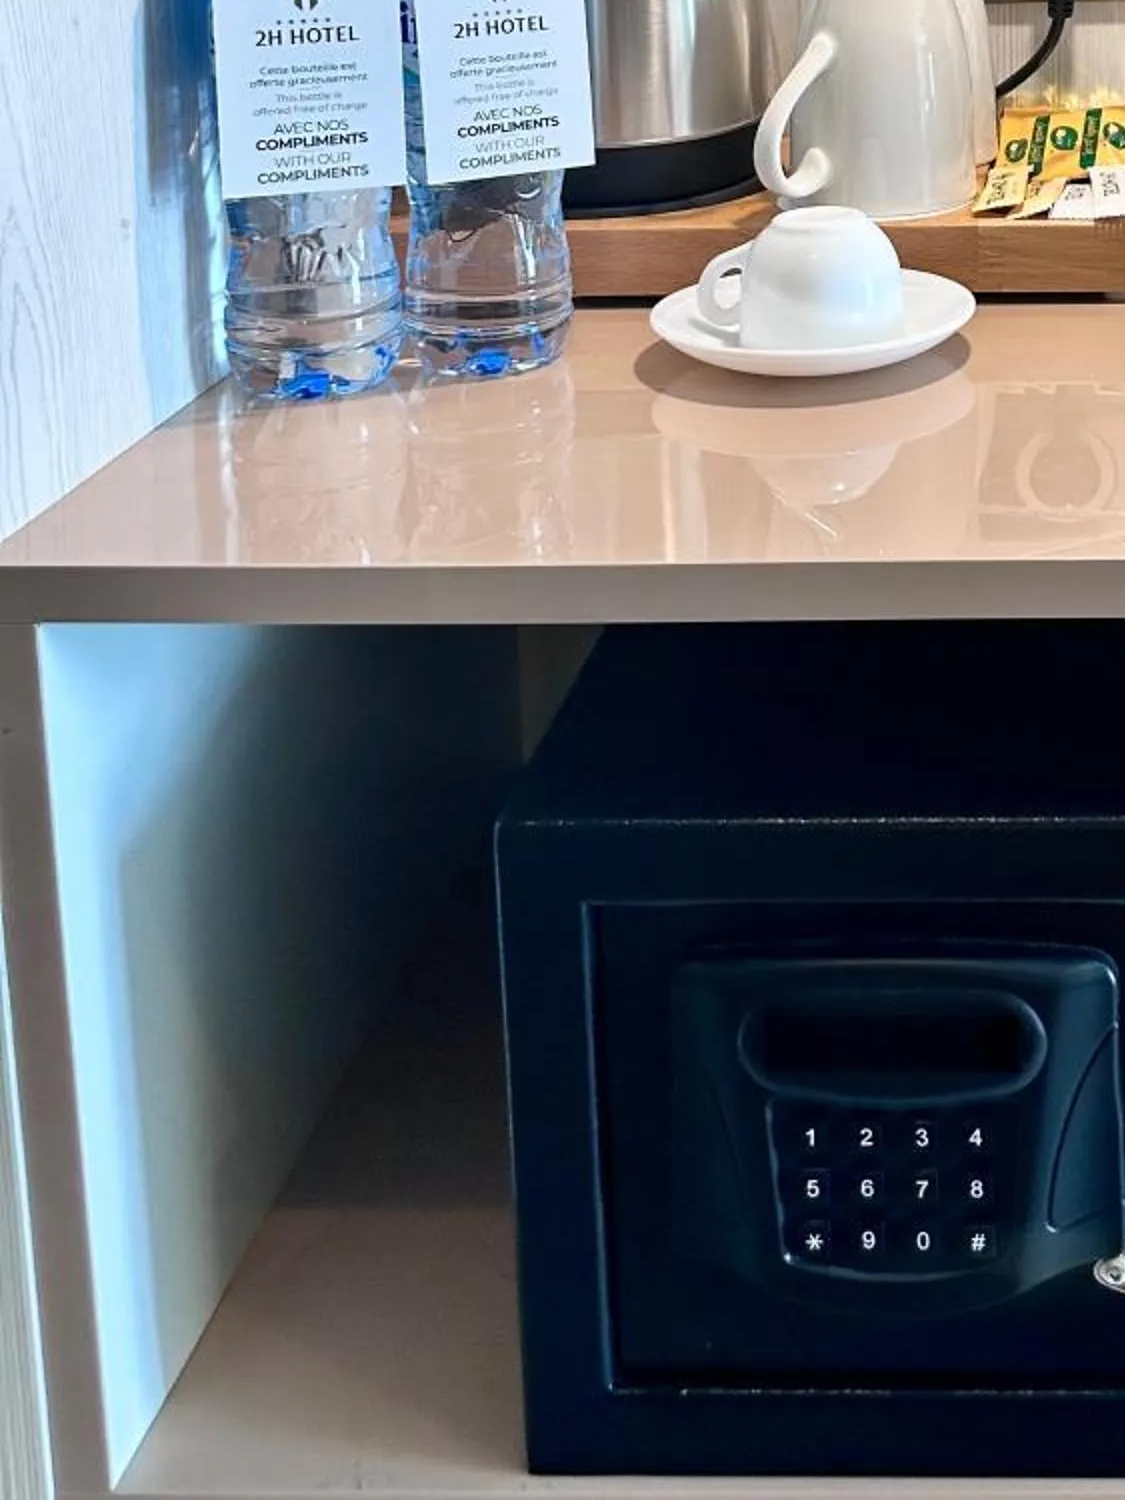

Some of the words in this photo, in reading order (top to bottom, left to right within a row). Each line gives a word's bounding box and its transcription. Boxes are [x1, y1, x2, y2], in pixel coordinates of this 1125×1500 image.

[255, 30, 283, 47] 2H
[290, 25, 361, 45] HOTEL
[453, 21, 479, 39] 2H
[485, 15, 550, 36] HOTEL
[473, 108, 510, 122] AVEC
[513, 104, 543, 118] NOS
[273, 121, 314, 135] AVEC
[317, 118, 350, 132] NOS
[457, 116, 561, 139] COMPLIMENTS
[255, 131, 370, 151] COMPLIMENTS
[475, 139, 511, 153] WITH
[514, 135, 546, 150] OUR
[274, 155, 315, 168] WITH
[317, 151, 352, 165] OUR
[459, 146, 562, 170] COMPLIMENTS
[257, 164, 370, 185] COMPLIMENTS
[805, 1127, 817, 1148] 1
[859, 1127, 875, 1148] 2
[914, 1127, 930, 1148] 3
[968, 1127, 984, 1147] 4
[805, 1178, 821, 1199] 5
[860, 1178, 876, 1198] 6
[915, 1179, 930, 1199] 7
[969, 1179, 985, 1199] 8
[861, 1231, 877, 1250] 9
[916, 1231, 931, 1252] 0
